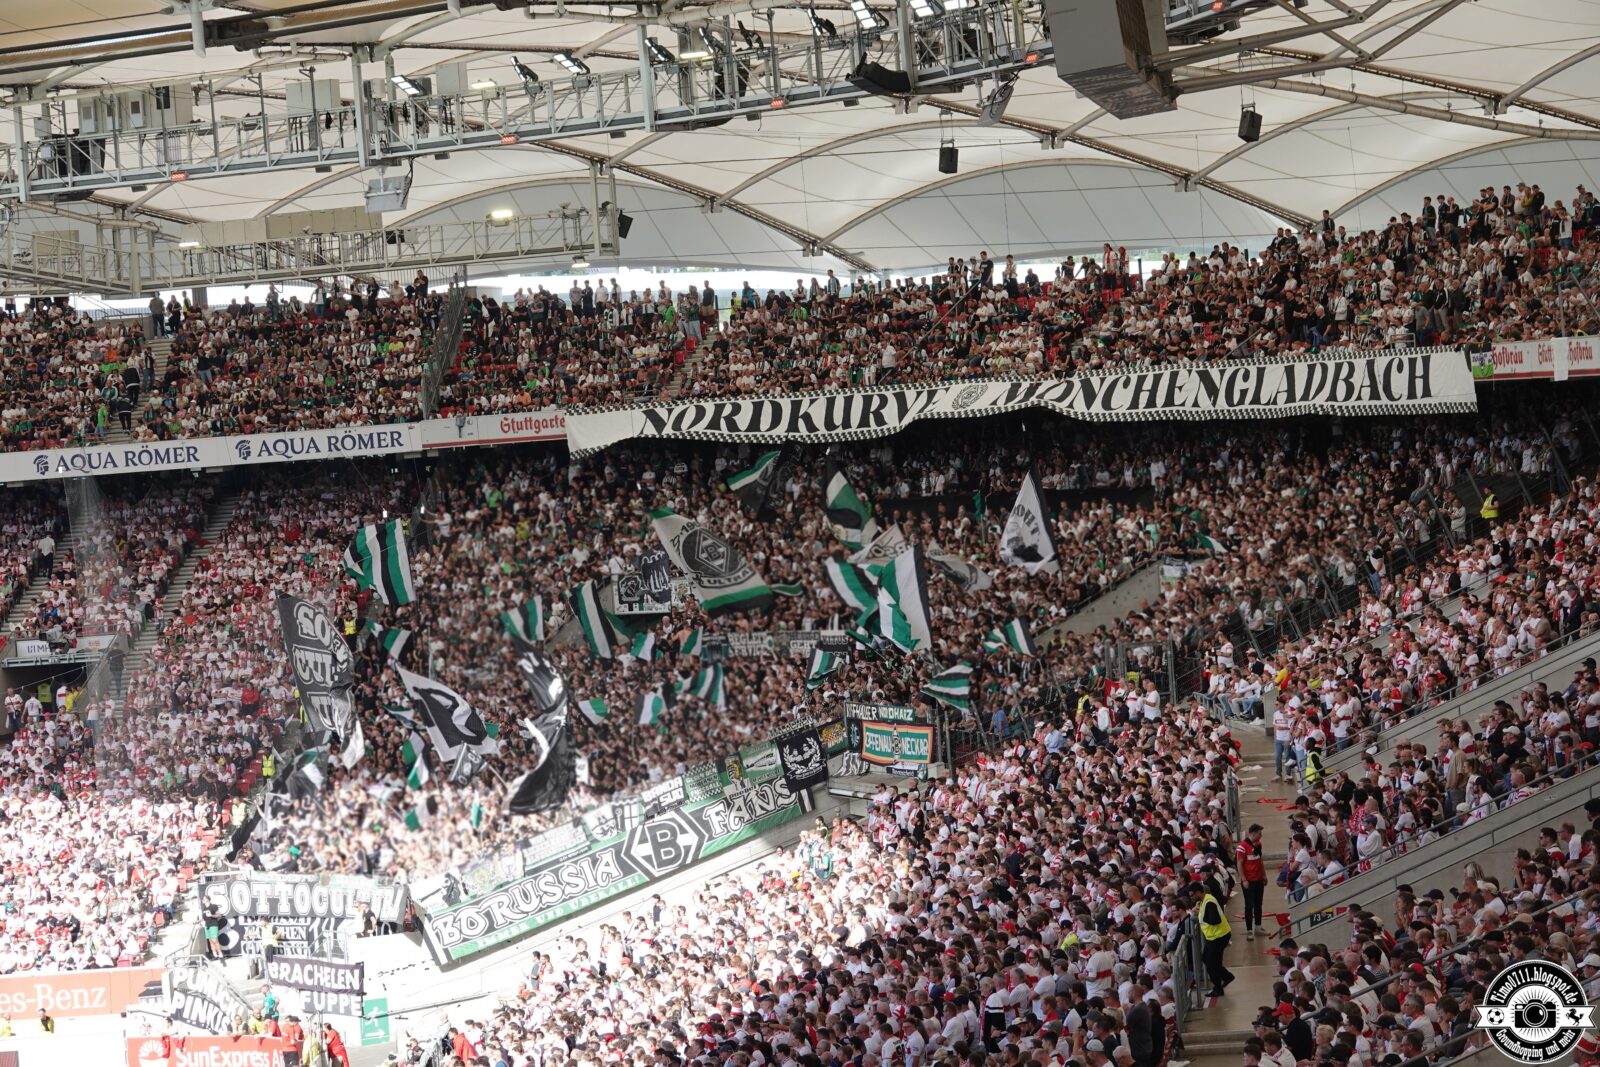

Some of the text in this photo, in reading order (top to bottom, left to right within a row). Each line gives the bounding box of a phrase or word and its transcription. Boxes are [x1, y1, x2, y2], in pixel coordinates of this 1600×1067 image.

[641, 386, 953, 435] NORDKURVE
[54, 444, 200, 474] AQUA RÖMER
[257, 429, 404, 460] AQUA RÖMER
[432, 848, 623, 948] BORUSSIA
[702, 775, 799, 838] FANS
[268, 961, 361, 990] BRACHELEN
[0, 983, 106, 1013] es-Benz
[176, 1045, 270, 1067] SunExpress
